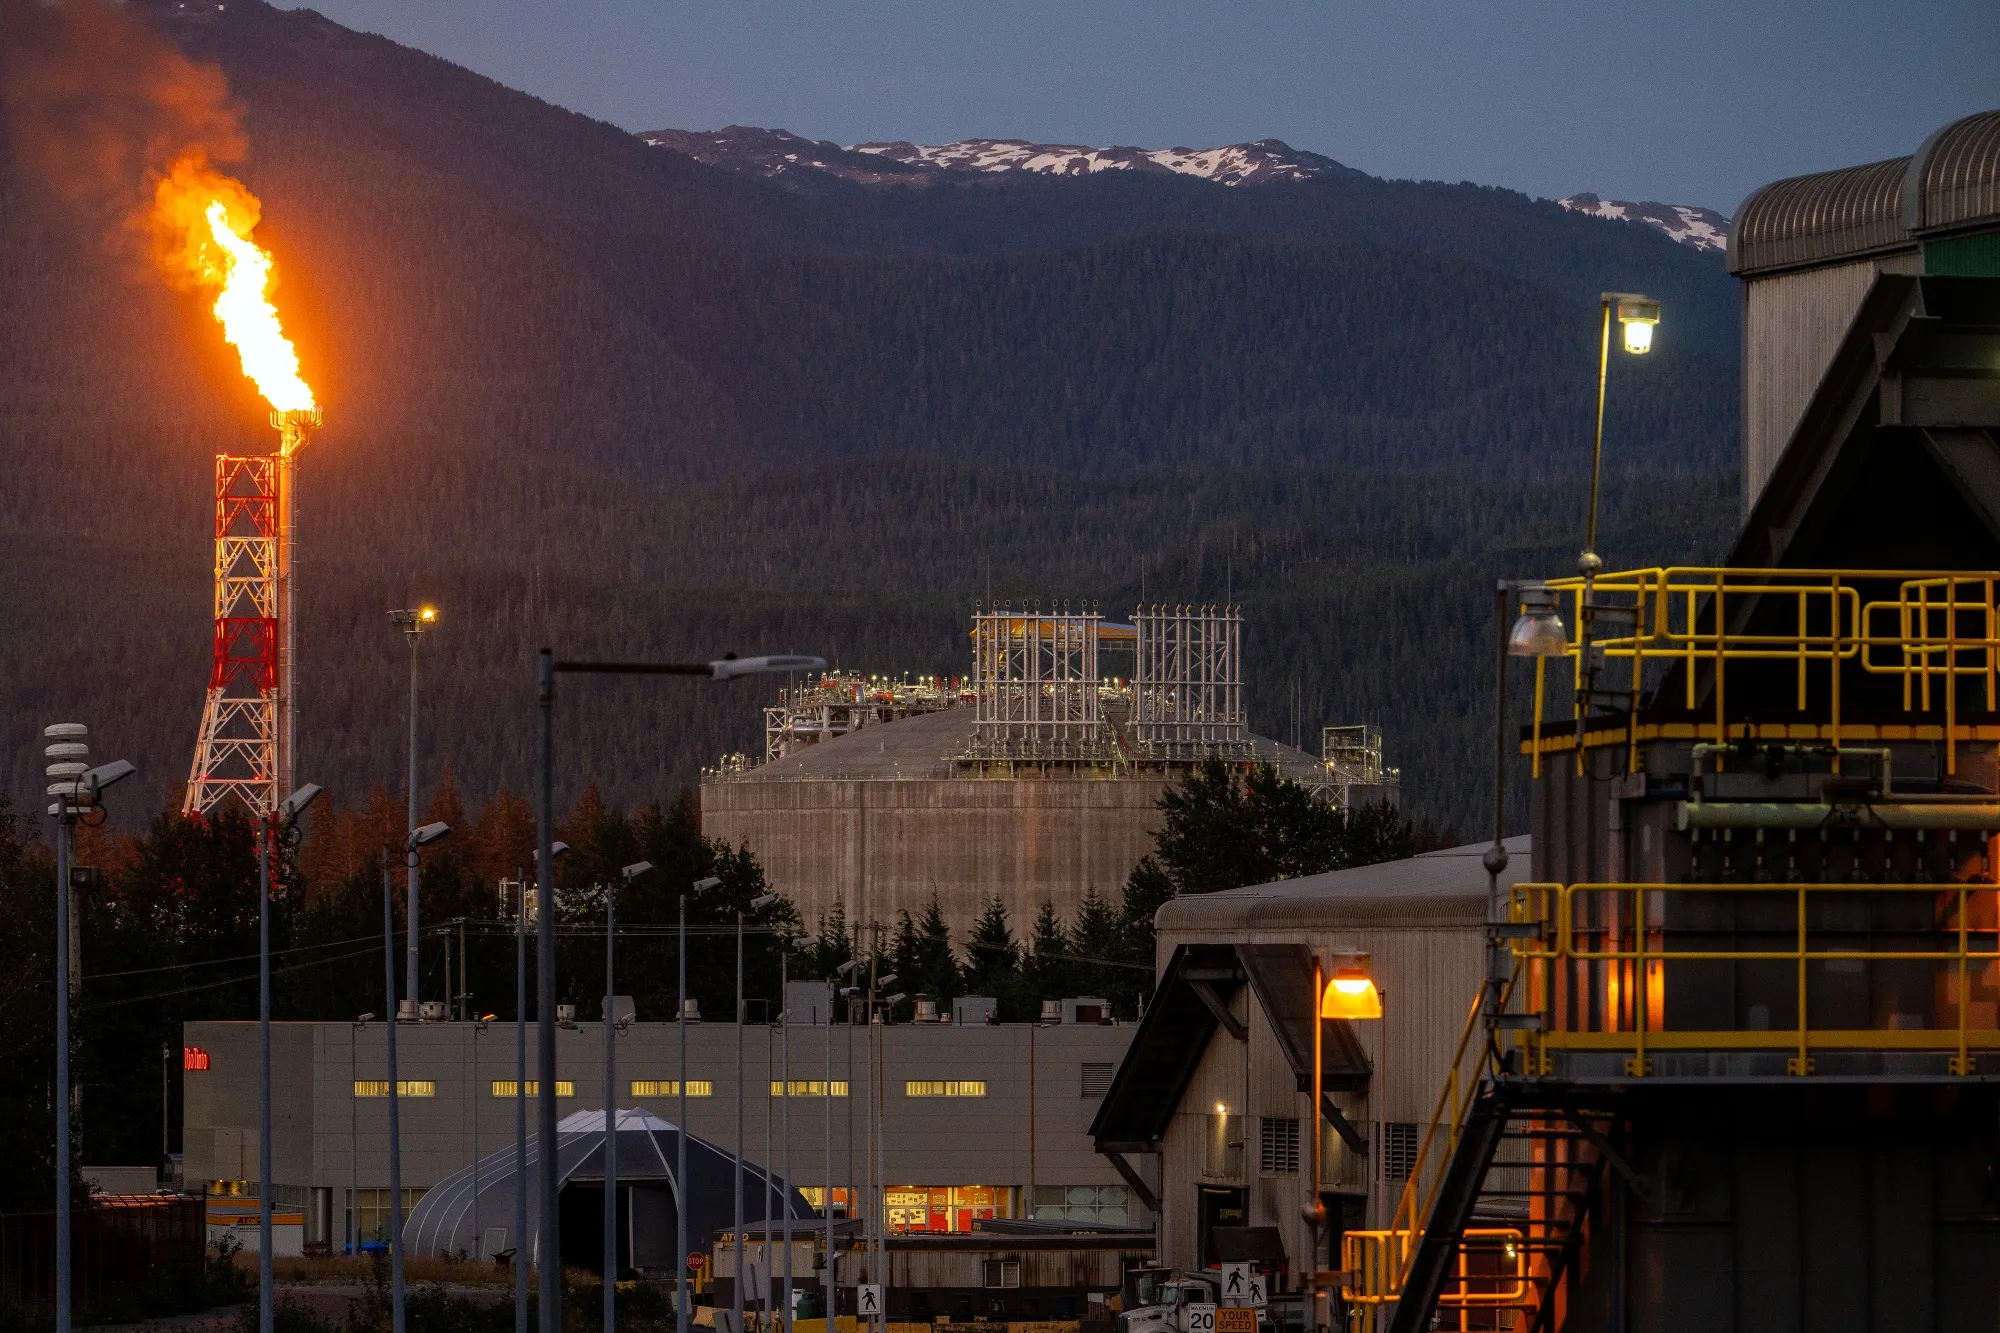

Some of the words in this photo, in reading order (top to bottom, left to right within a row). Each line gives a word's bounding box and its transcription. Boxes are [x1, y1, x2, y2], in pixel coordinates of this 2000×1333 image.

[688, 1257, 704, 1265] STOP
[1221, 1310, 1250, 1320] YOUR
[1190, 1312, 1214, 1329] 20
[1219, 1320, 1252, 1330] SPEED
